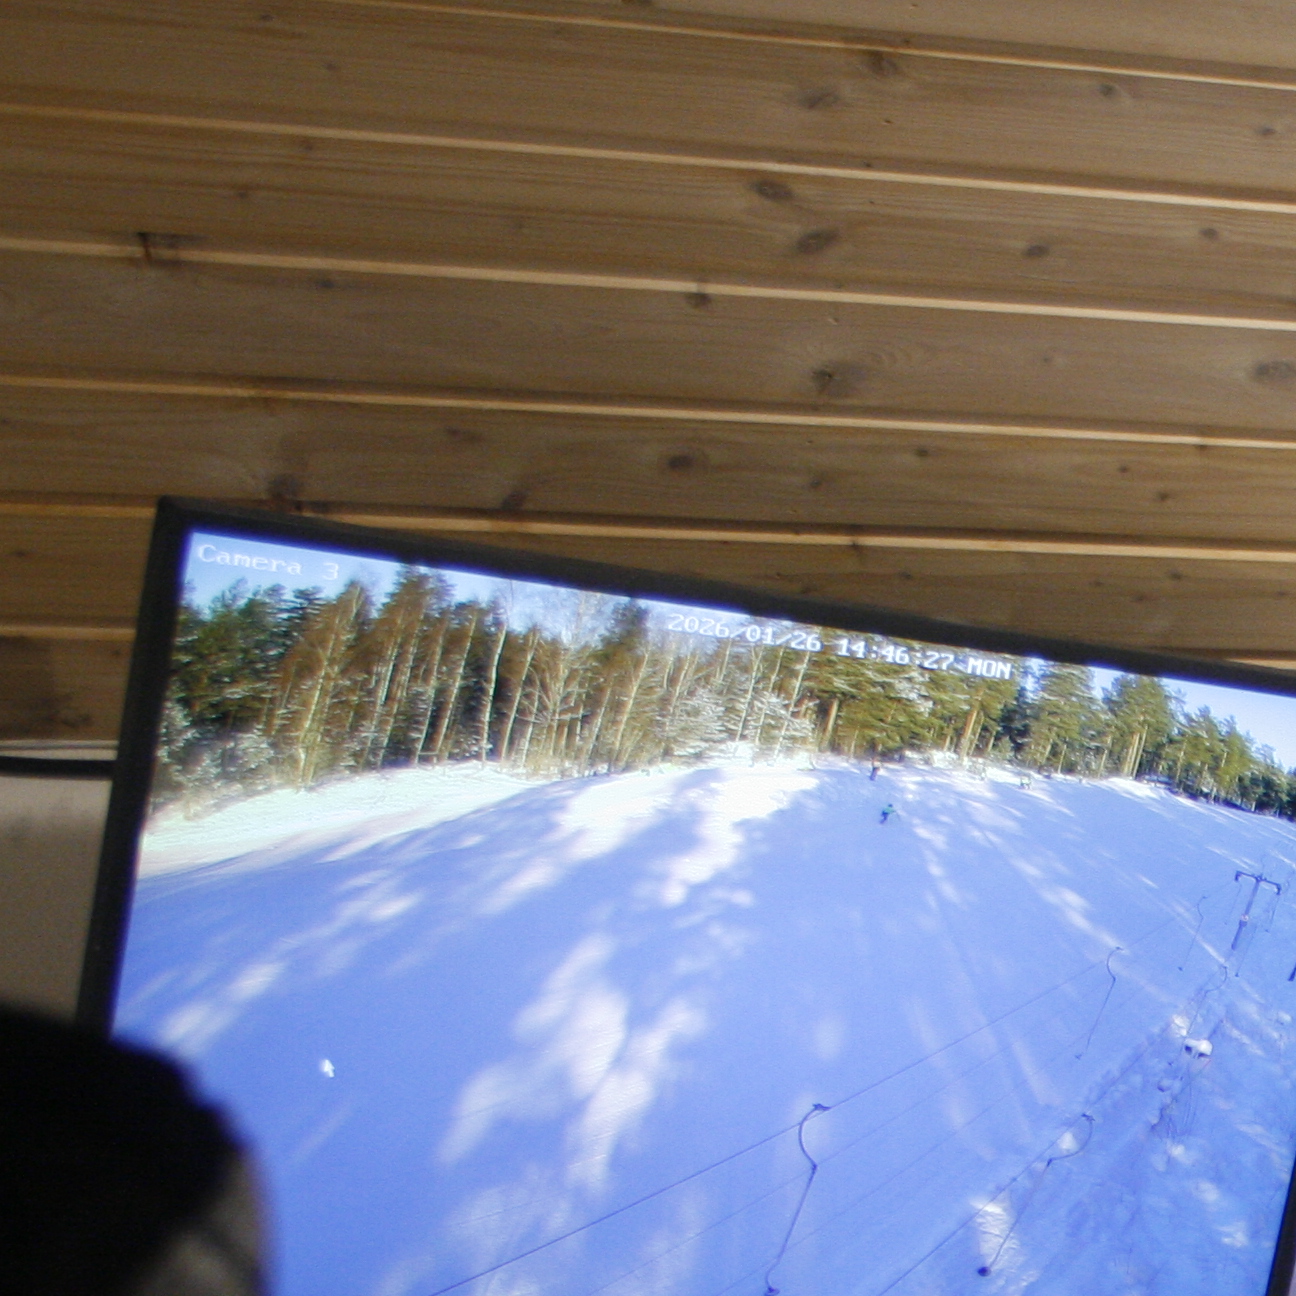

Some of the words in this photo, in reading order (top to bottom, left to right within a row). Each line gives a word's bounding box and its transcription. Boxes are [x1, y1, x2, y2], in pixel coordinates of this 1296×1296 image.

[198, 544, 302, 575] Camera
[322, 562, 340, 580] 3
[667, 613, 823, 652] 2026/01/26
[836, 637, 955, 670] 14:46:27
[967, 656, 1012, 680] MON
